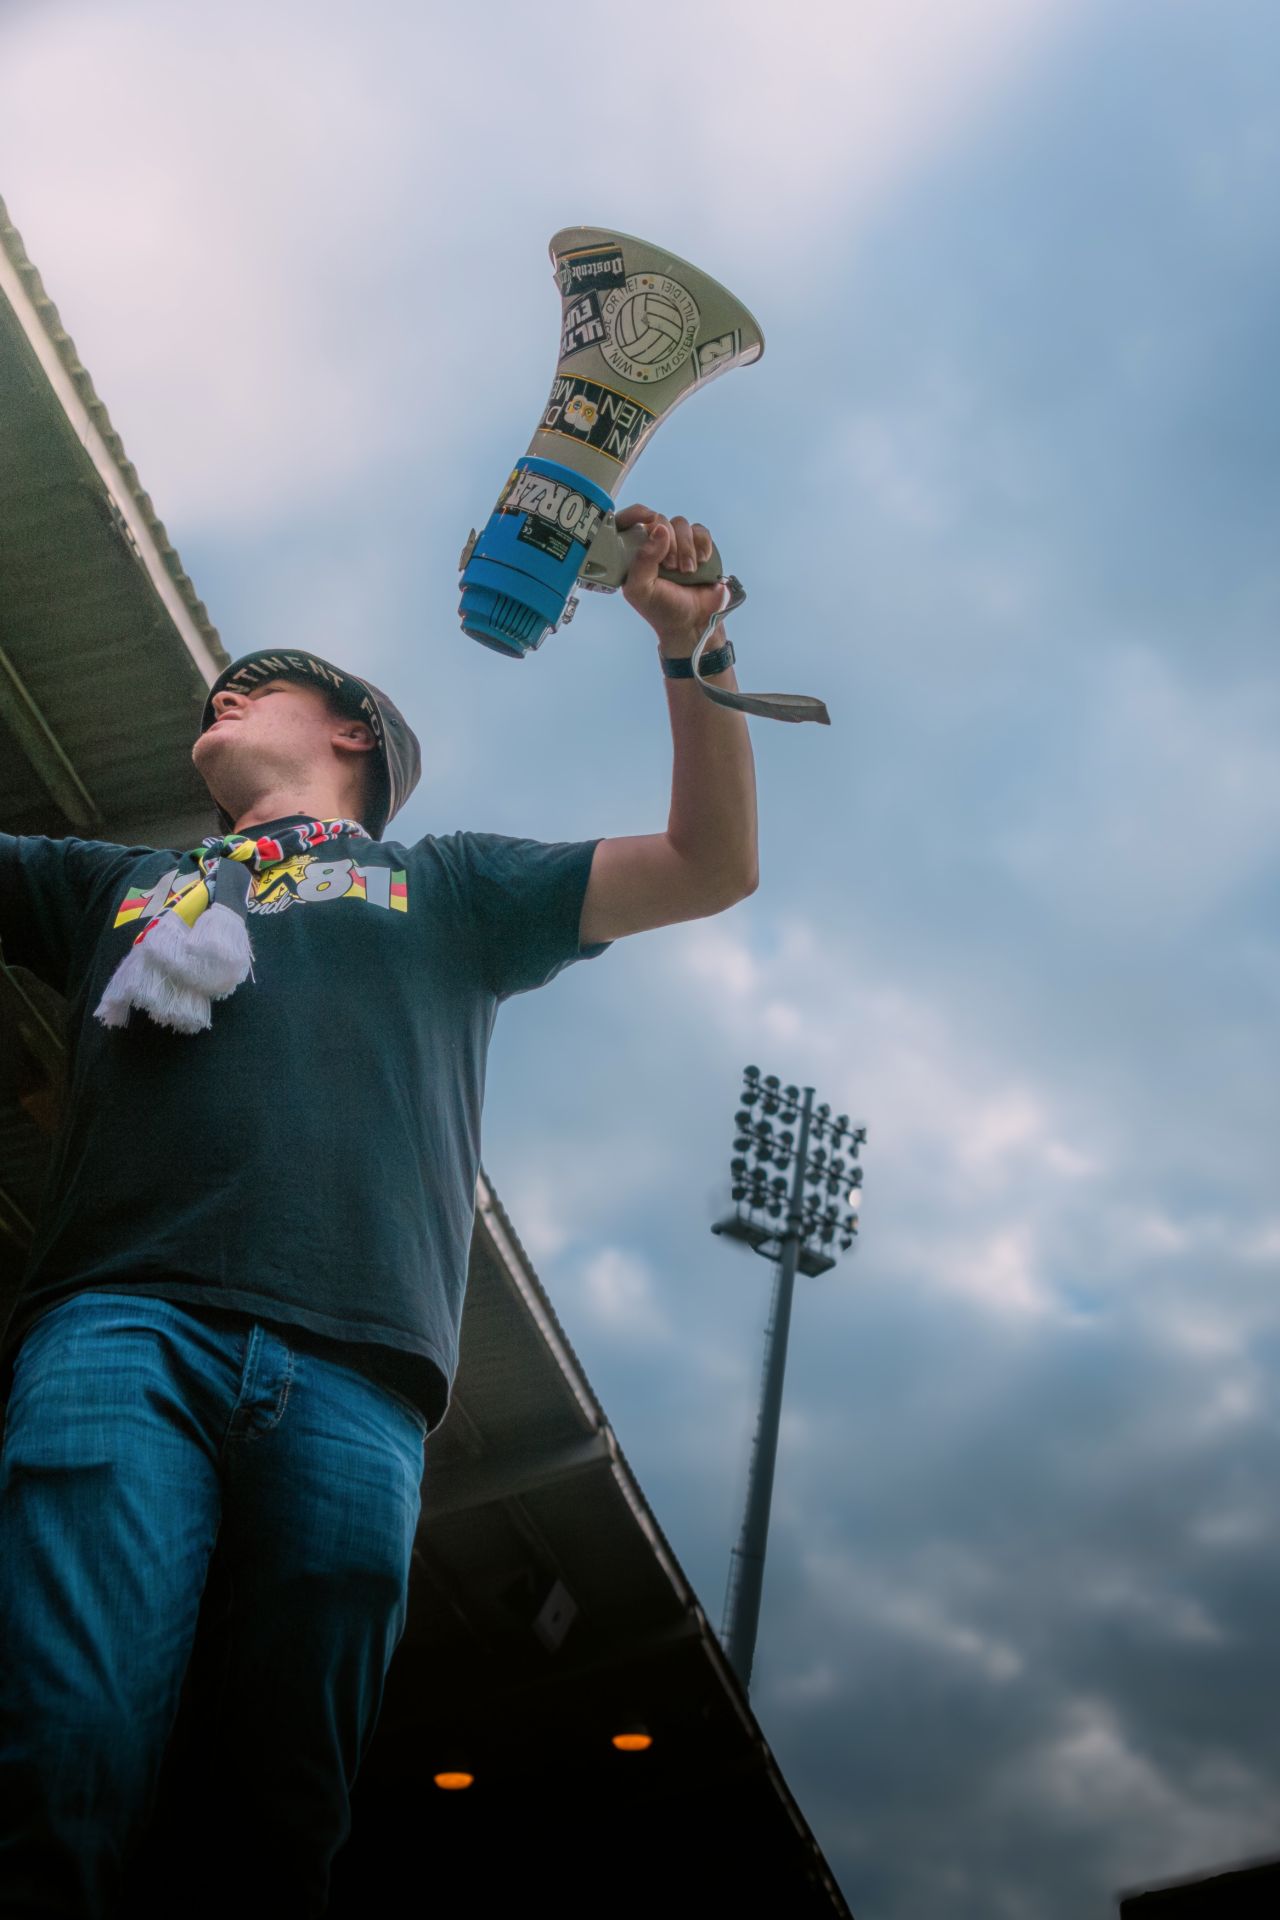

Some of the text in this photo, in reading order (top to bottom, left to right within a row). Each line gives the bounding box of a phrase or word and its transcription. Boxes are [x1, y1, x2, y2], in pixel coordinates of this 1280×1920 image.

[572, 257, 623, 281] Oostende
[673, 325, 696, 367] OSTEND
[505, 471, 600, 543] FORZA
